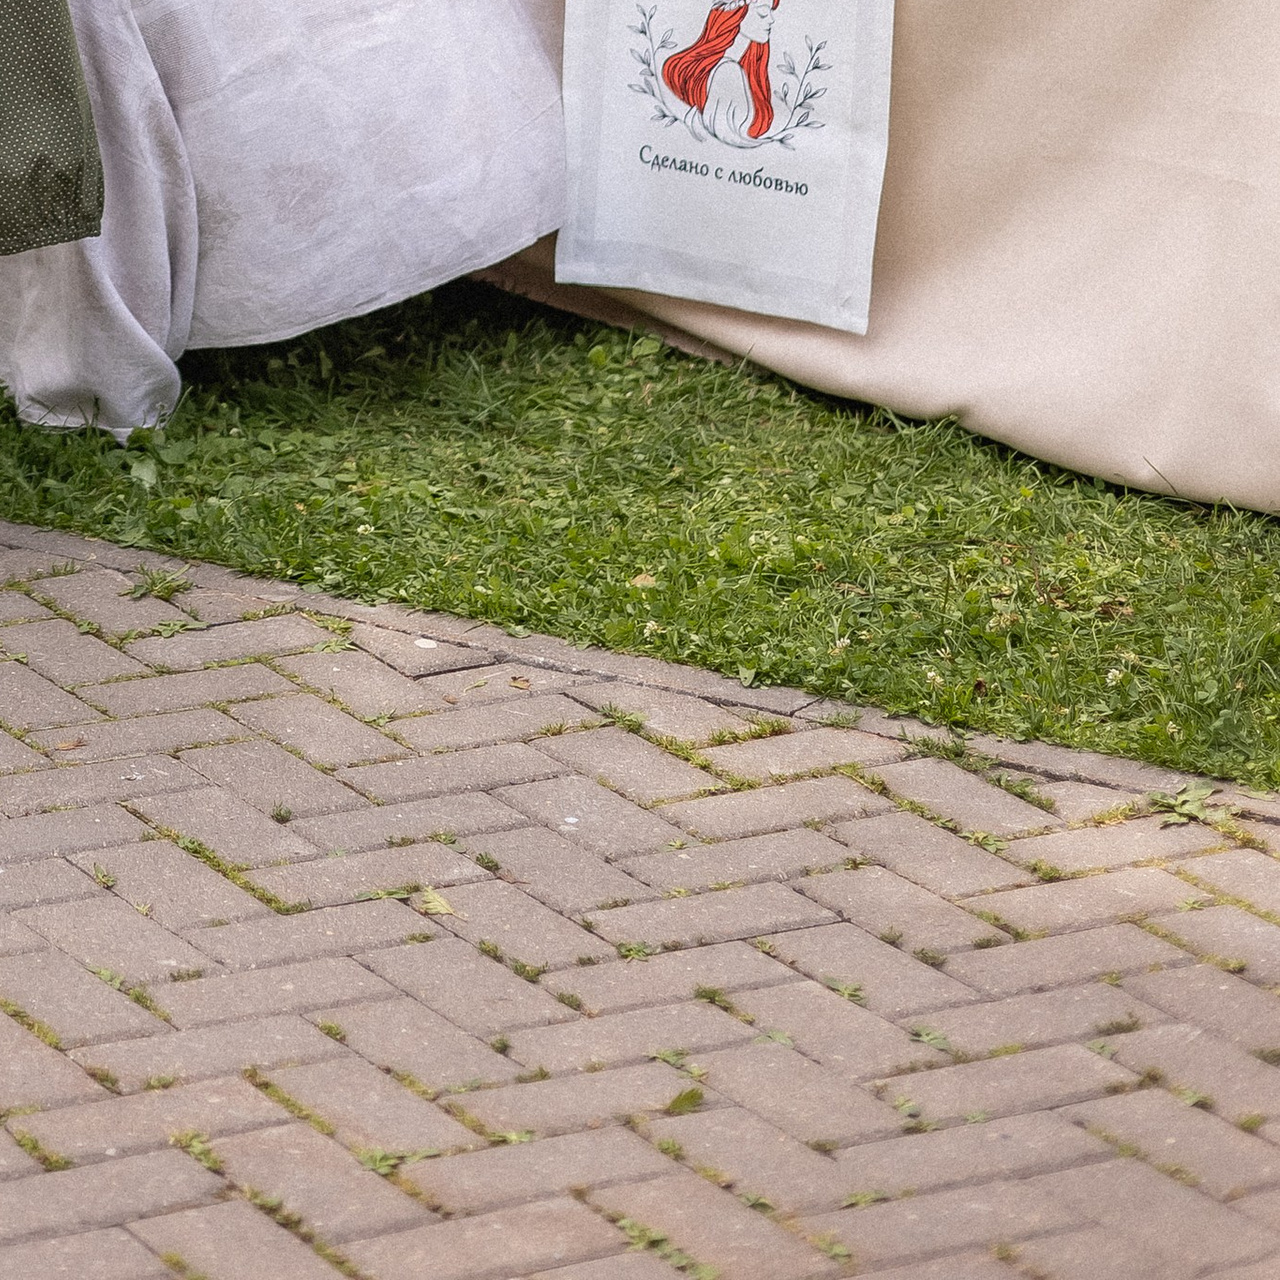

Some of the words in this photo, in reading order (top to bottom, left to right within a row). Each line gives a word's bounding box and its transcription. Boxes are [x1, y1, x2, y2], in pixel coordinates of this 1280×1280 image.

[638, 144, 710, 178] Сделано
[714, 167, 724, 181] с
[727, 167, 810, 197] любовью
